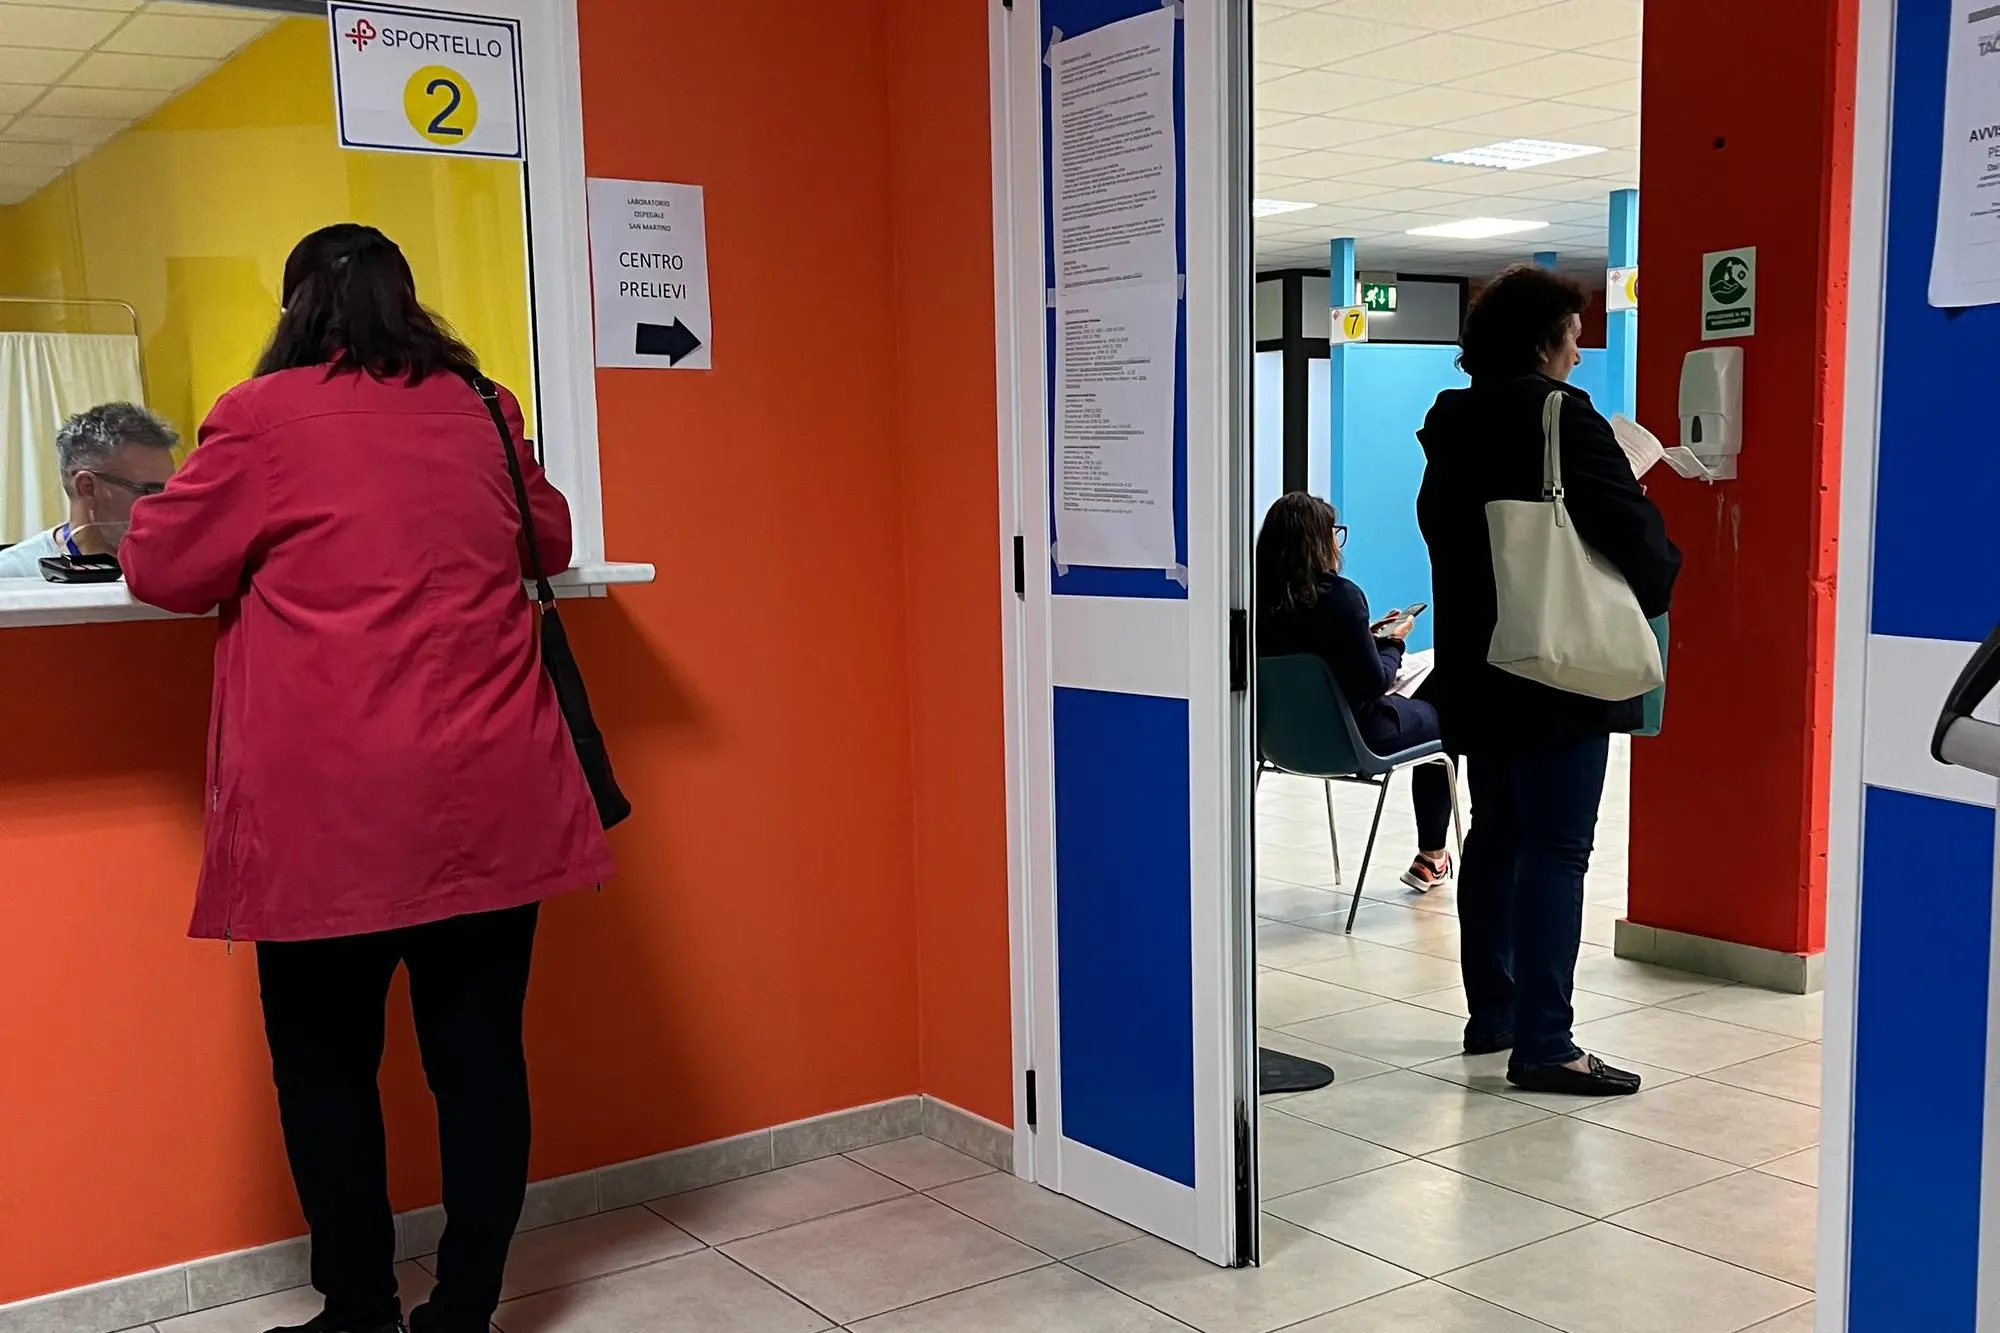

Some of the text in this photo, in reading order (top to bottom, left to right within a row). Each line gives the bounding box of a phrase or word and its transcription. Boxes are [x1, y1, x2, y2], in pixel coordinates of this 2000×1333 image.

[382, 28, 502, 58] SPORTELLO
[426, 78, 464, 136] 2
[627, 198, 670, 207] LABORATORIO
[634, 211, 664, 219] OSPEDALE
[642, 224, 671, 232] MARTINO
[619, 252, 683, 270] CENTRO
[620, 281, 687, 299] PRELIEVI
[1349, 314, 1360, 335] 7
